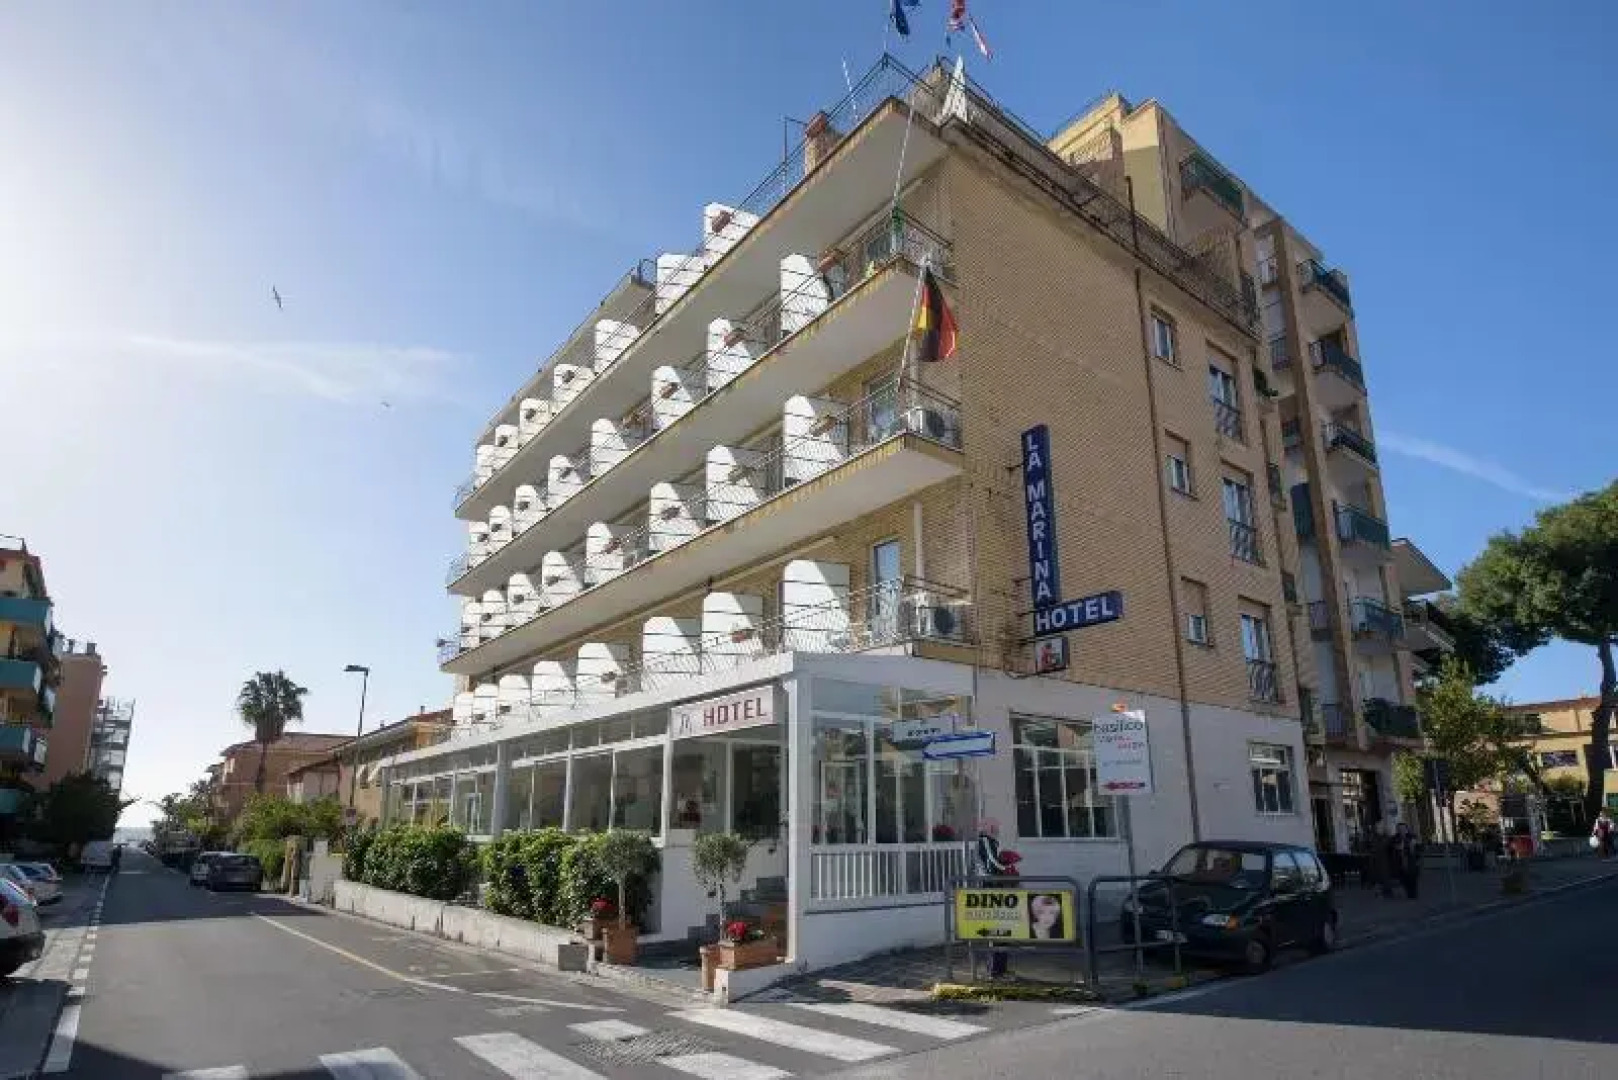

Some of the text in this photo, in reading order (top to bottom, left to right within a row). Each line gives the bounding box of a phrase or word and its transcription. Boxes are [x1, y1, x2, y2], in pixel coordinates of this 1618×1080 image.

[1026, 434, 1052, 600] LA MARINA
[1036, 596, 1113, 632] HOTEL
[703, 698, 767, 727] HOTEL
[966, 893, 1018, 908] DINO
